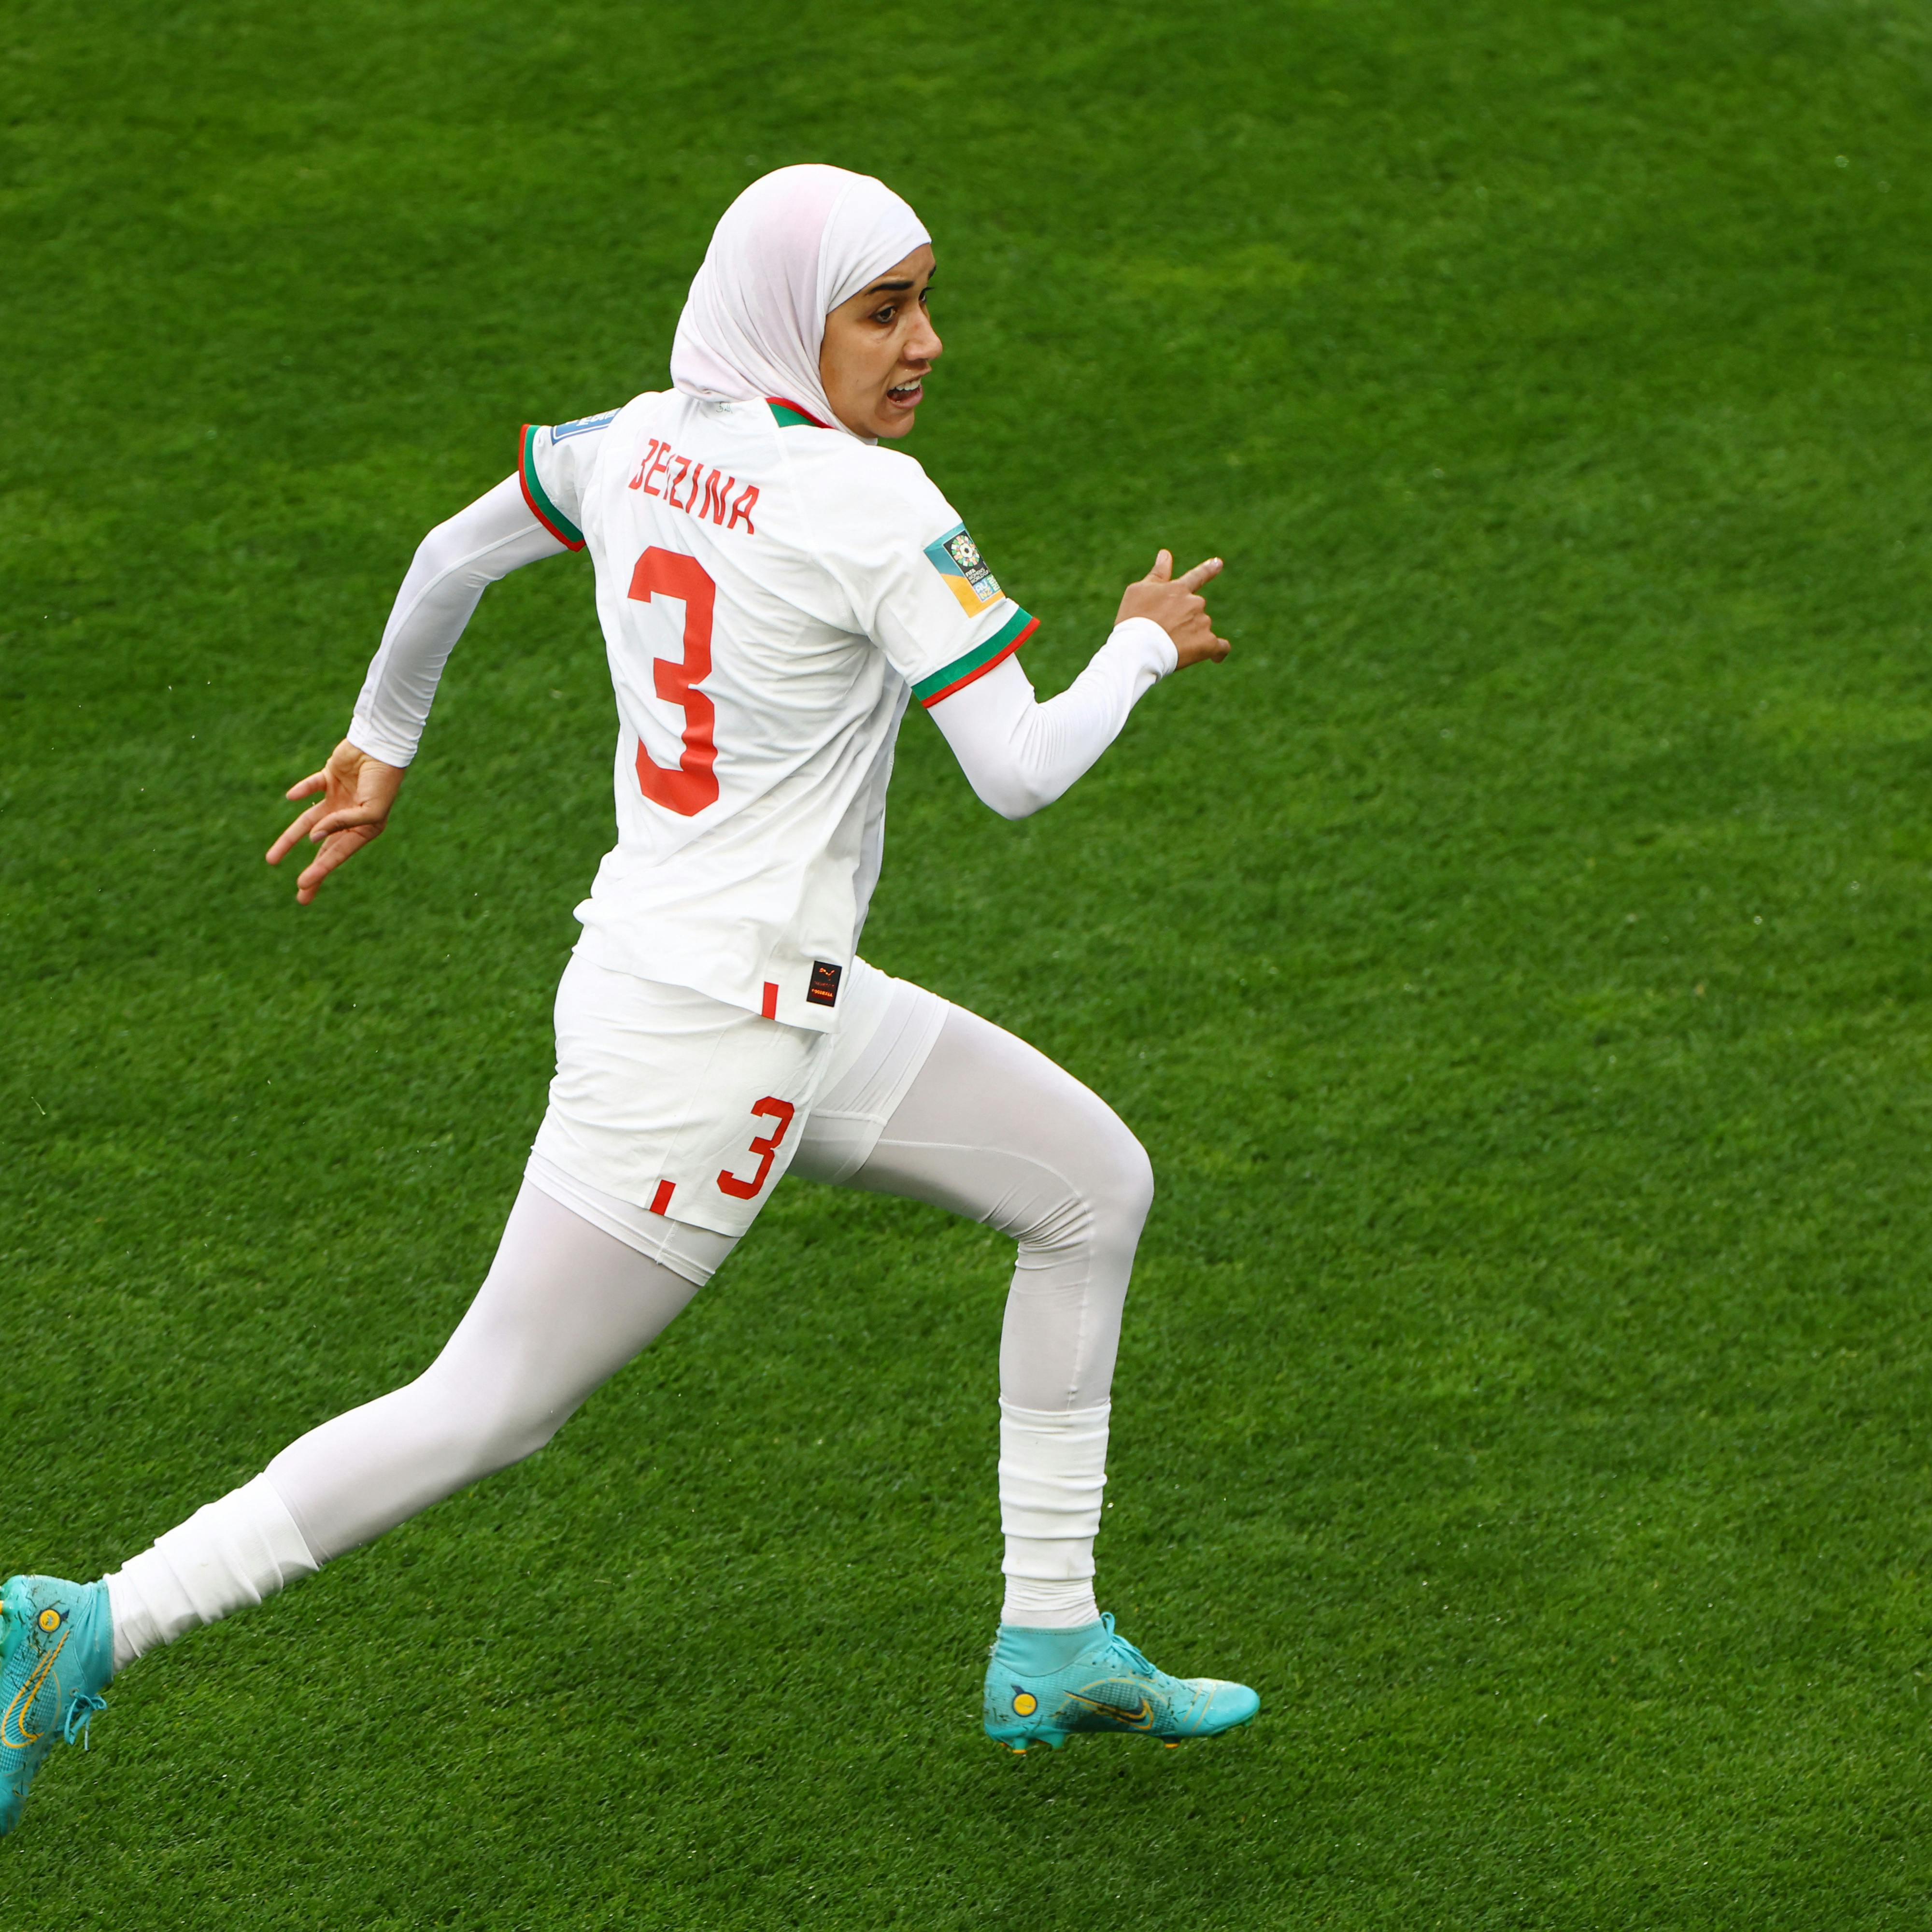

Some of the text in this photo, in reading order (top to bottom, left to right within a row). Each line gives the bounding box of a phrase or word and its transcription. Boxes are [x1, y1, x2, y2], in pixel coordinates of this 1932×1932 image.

[965, 568, 976, 577] FIFA
[970, 573, 984, 584] WORLD
[975, 579, 988, 593] AU
[979, 586, 993, 599] NZ
[628, 546, 719, 817] 3
[717, 1096, 795, 1200] 3
